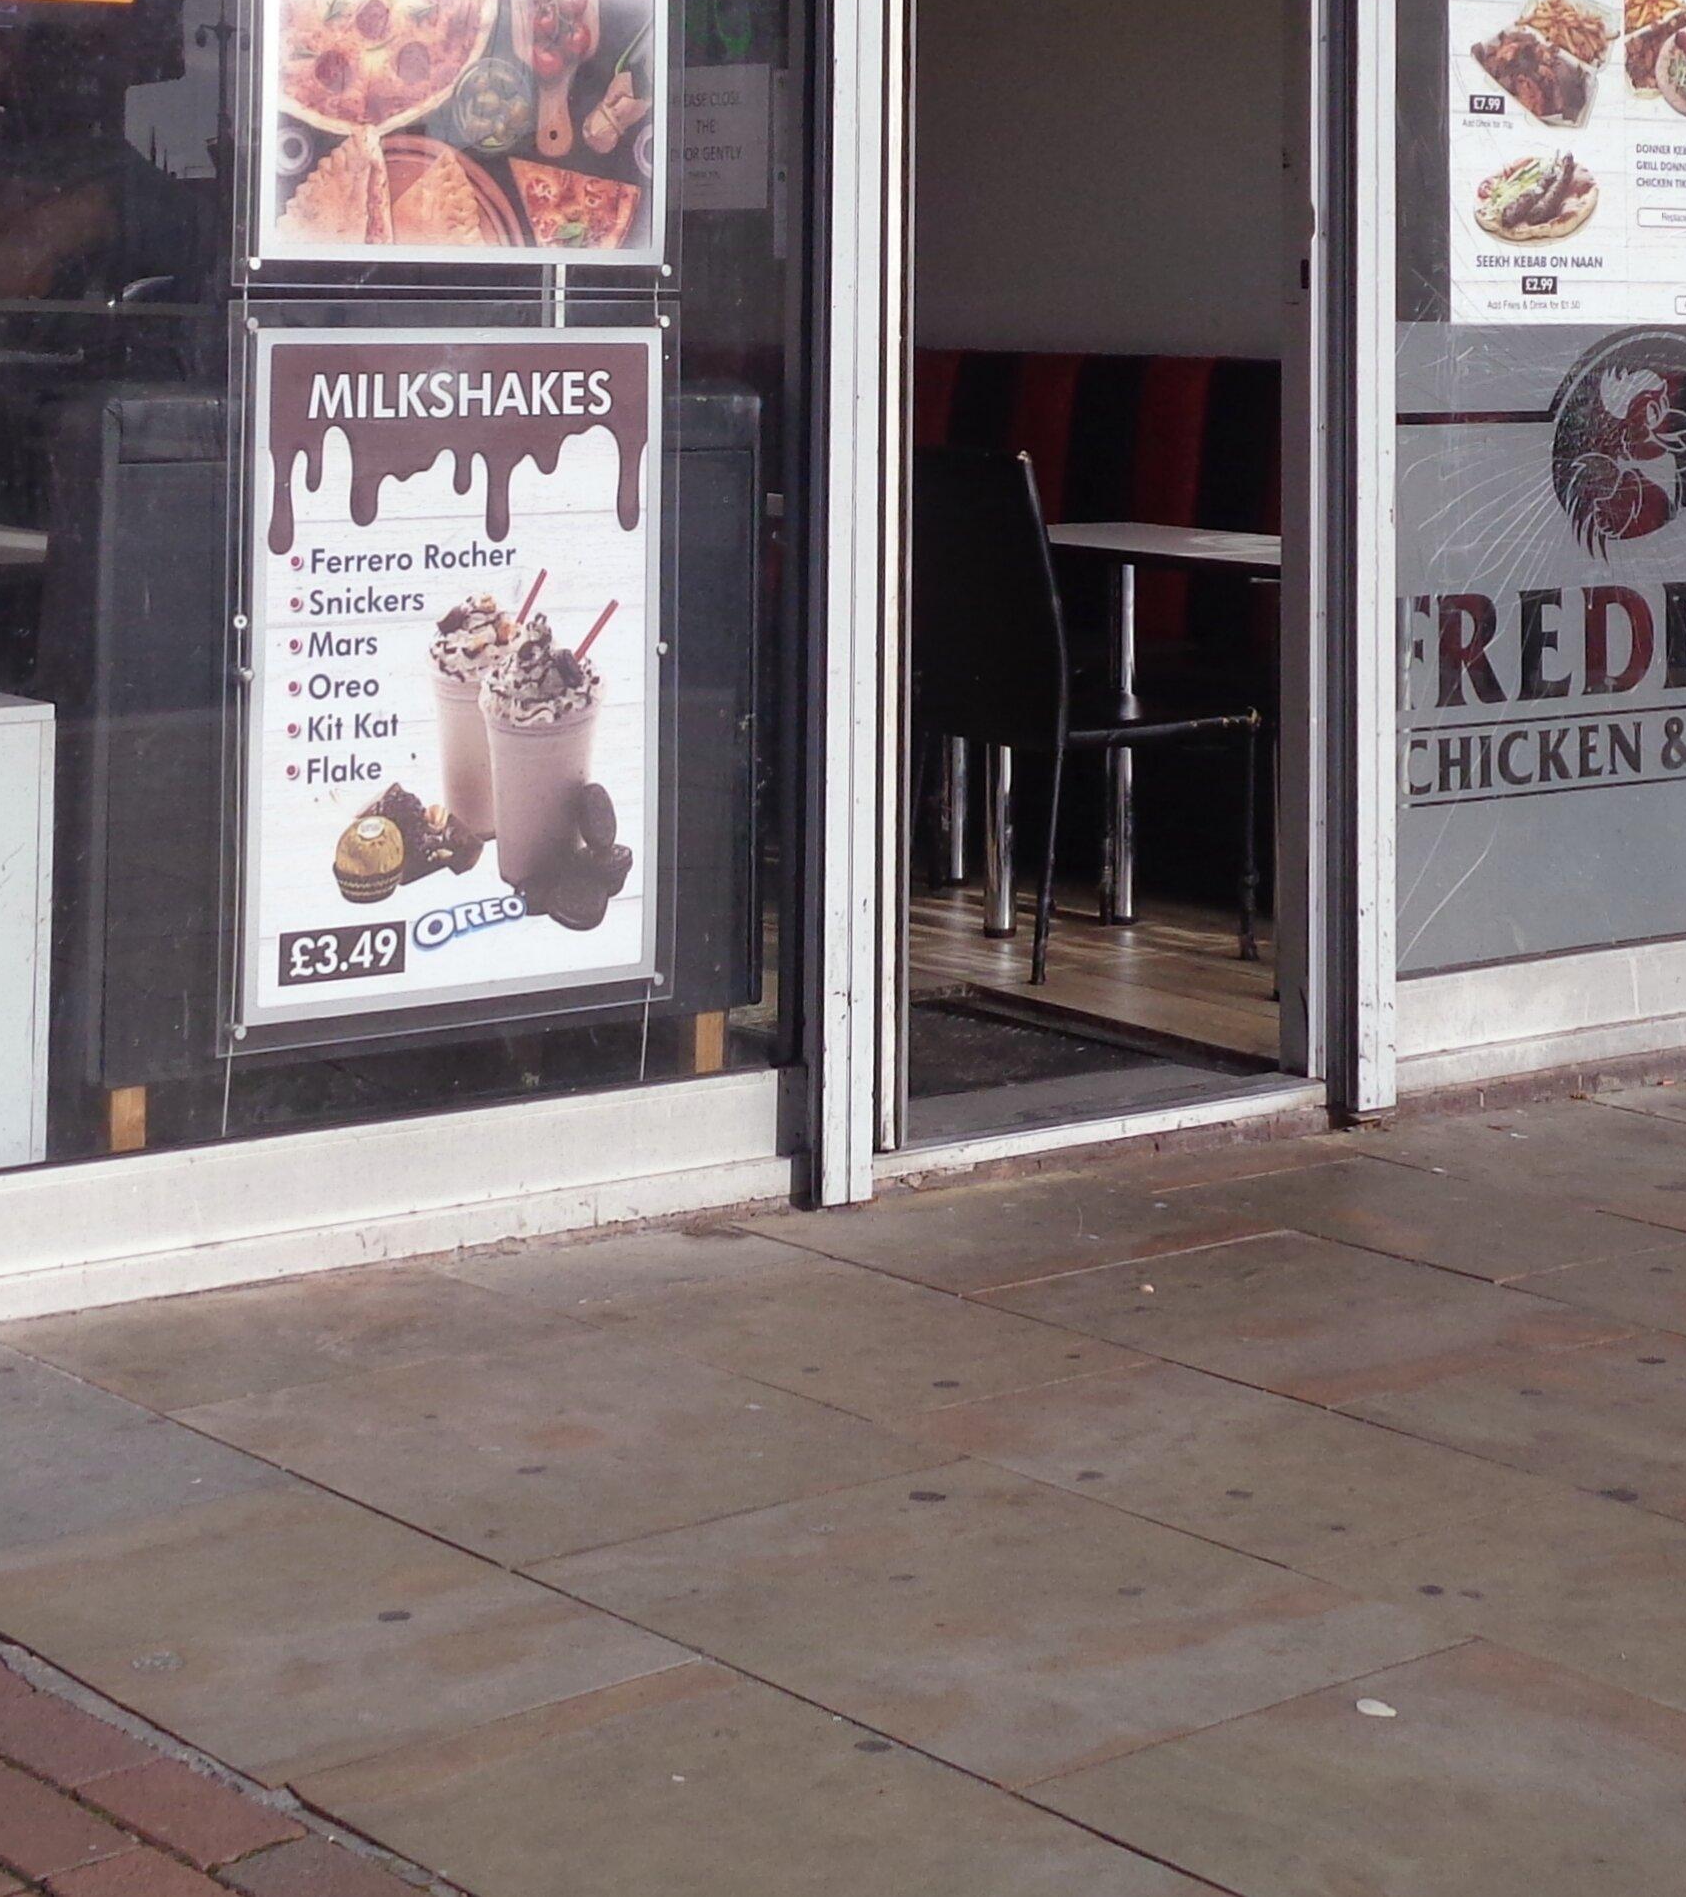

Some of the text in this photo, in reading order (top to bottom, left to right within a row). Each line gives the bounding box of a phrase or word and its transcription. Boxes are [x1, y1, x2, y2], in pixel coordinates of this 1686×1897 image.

[1473, 97, 1502, 111] £7.99
[696, 119, 716, 134] THE
[1636, 144, 1671, 154] DONNER
[1636, 177, 1673, 188] CHICKEN
[1476, 255, 1603, 268] SEEKH KEBAB ON NAAN
[1525, 278, 1553, 292] £2.99
[307, 369, 613, 421] MILKSHAKES
[310, 543, 517, 576] Ferrero Rocher
[308, 589, 425, 616] Snickers
[307, 631, 378, 658] Mars
[307, 674, 380, 701] Oreo
[306, 715, 399, 743] Kit Kat
[306, 757, 383, 784] Flake
[1403, 720, 1642, 796] CHICKEN
[414, 894, 526, 953] OREO
[288, 928, 400, 977] £3.49
